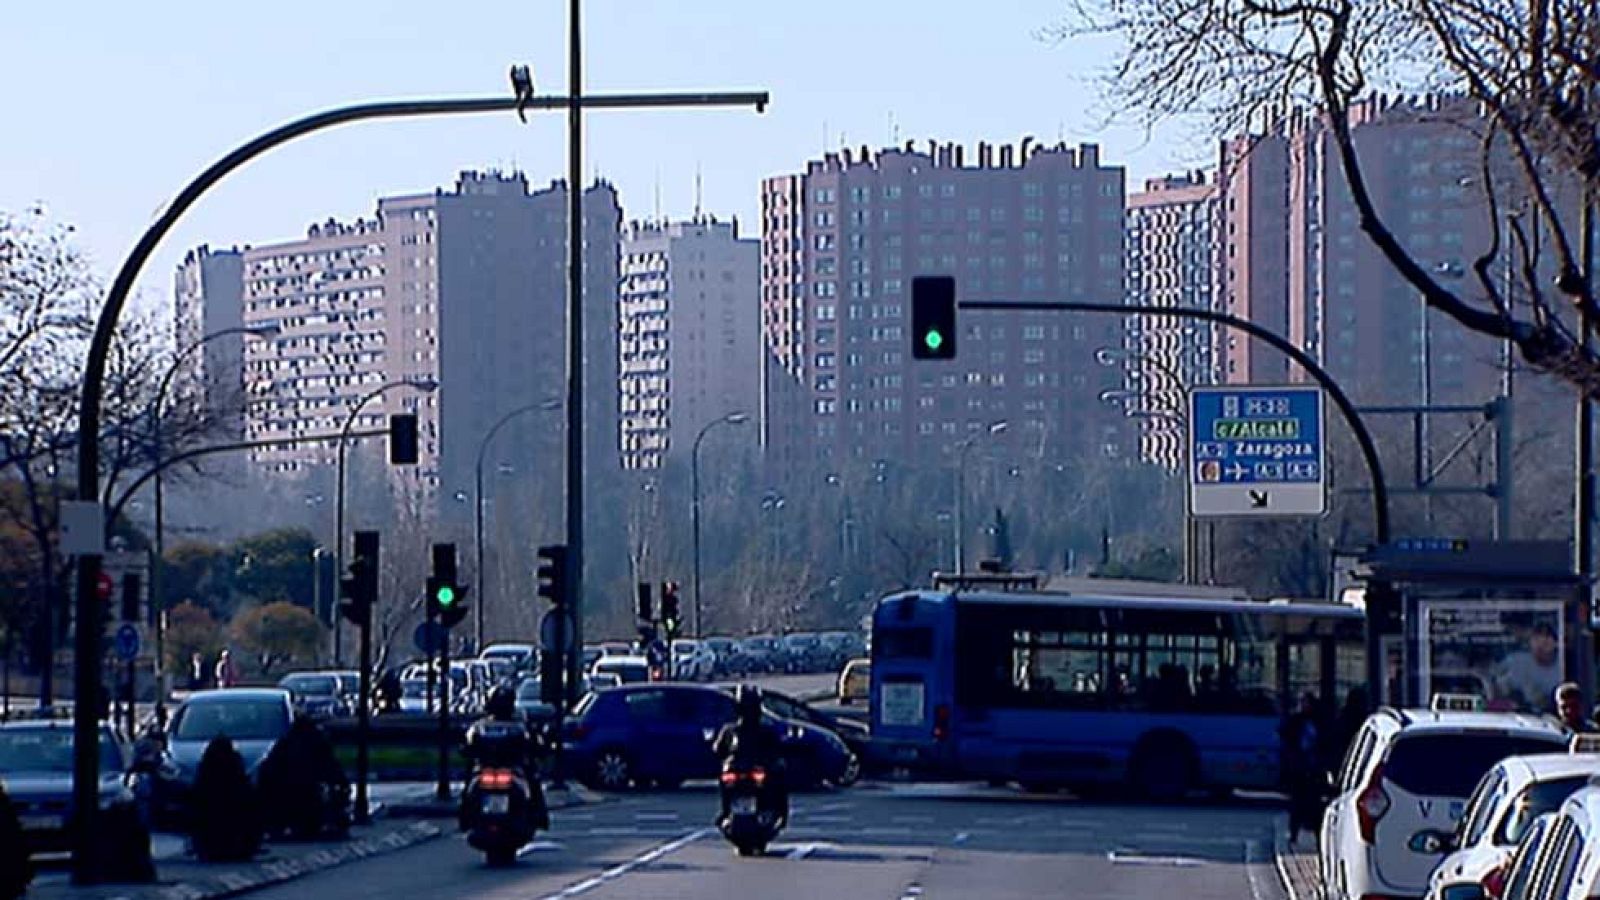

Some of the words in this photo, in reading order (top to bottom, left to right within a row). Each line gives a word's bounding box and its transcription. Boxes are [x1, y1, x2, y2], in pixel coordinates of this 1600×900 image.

[1247, 398, 1288, 415] M-30
[1235, 442, 1312, 459] Zaragoza
[1418, 799, 1433, 818] V
